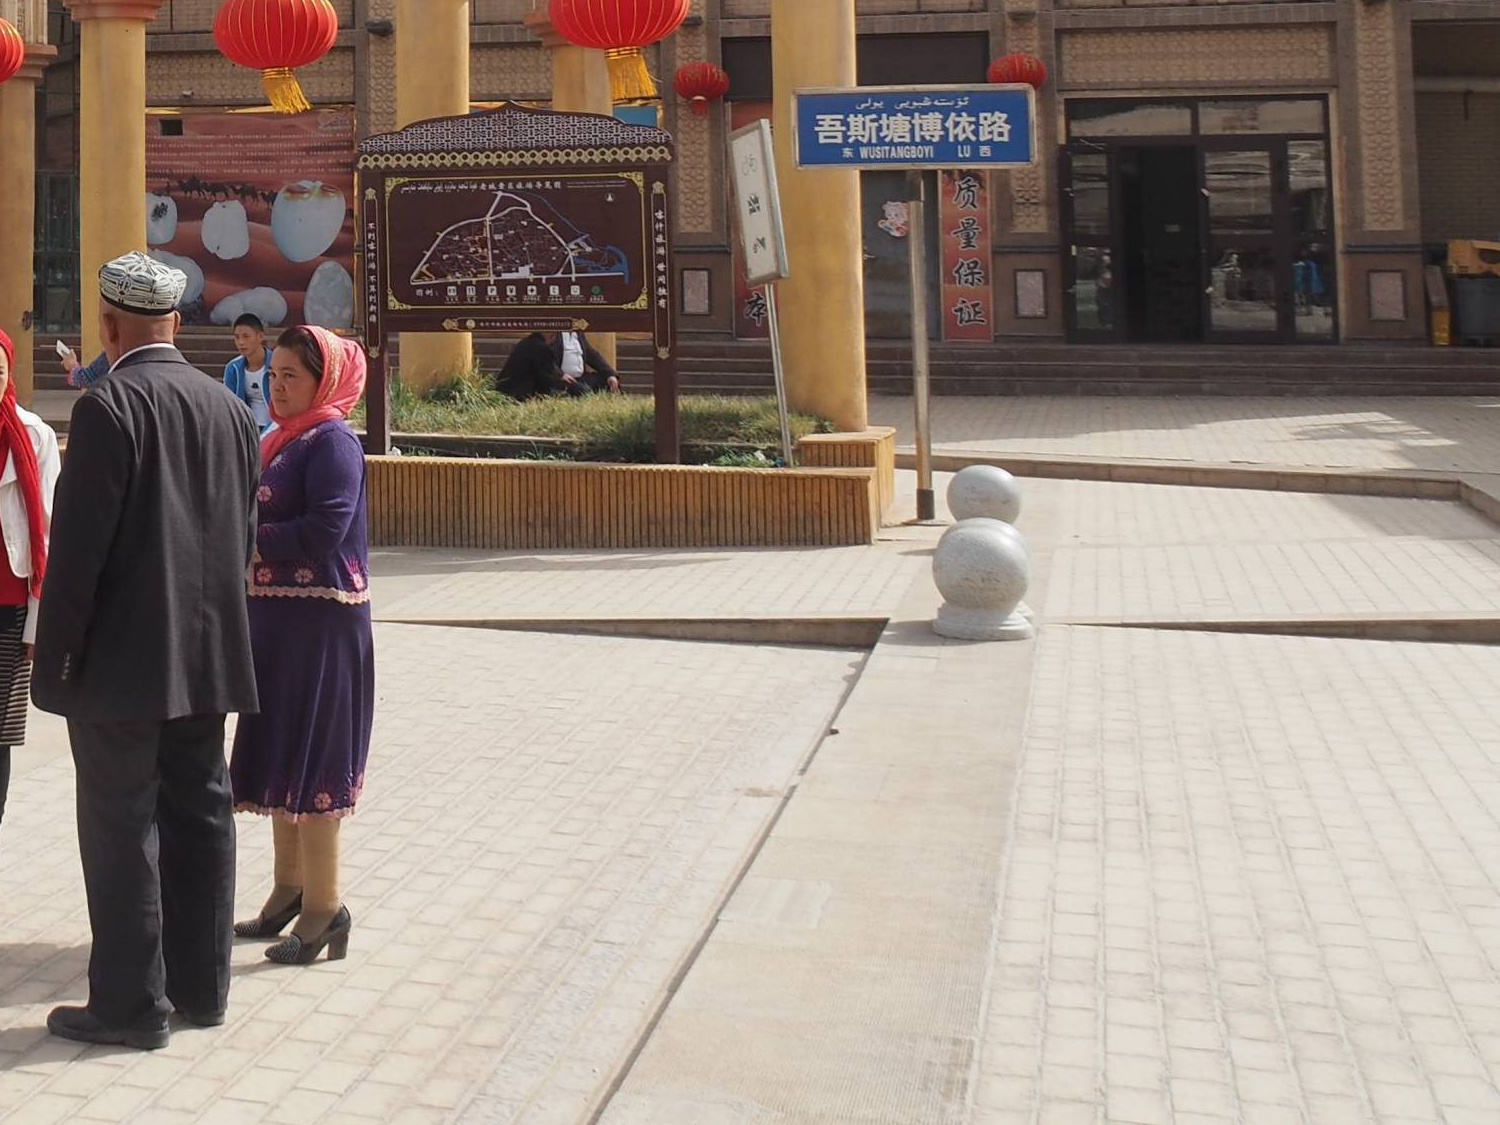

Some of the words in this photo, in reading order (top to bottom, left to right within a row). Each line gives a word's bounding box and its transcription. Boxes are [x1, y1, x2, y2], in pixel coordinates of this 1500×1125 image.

[814, 111, 1011, 144] 吾斯塘博依路
[842, 148, 853, 157] 东
[860, 146, 934, 159] WUSITANGBOYI
[958, 145, 970, 157] LU
[980, 145, 991, 157] 西
[953, 176, 987, 326] 质量保证
